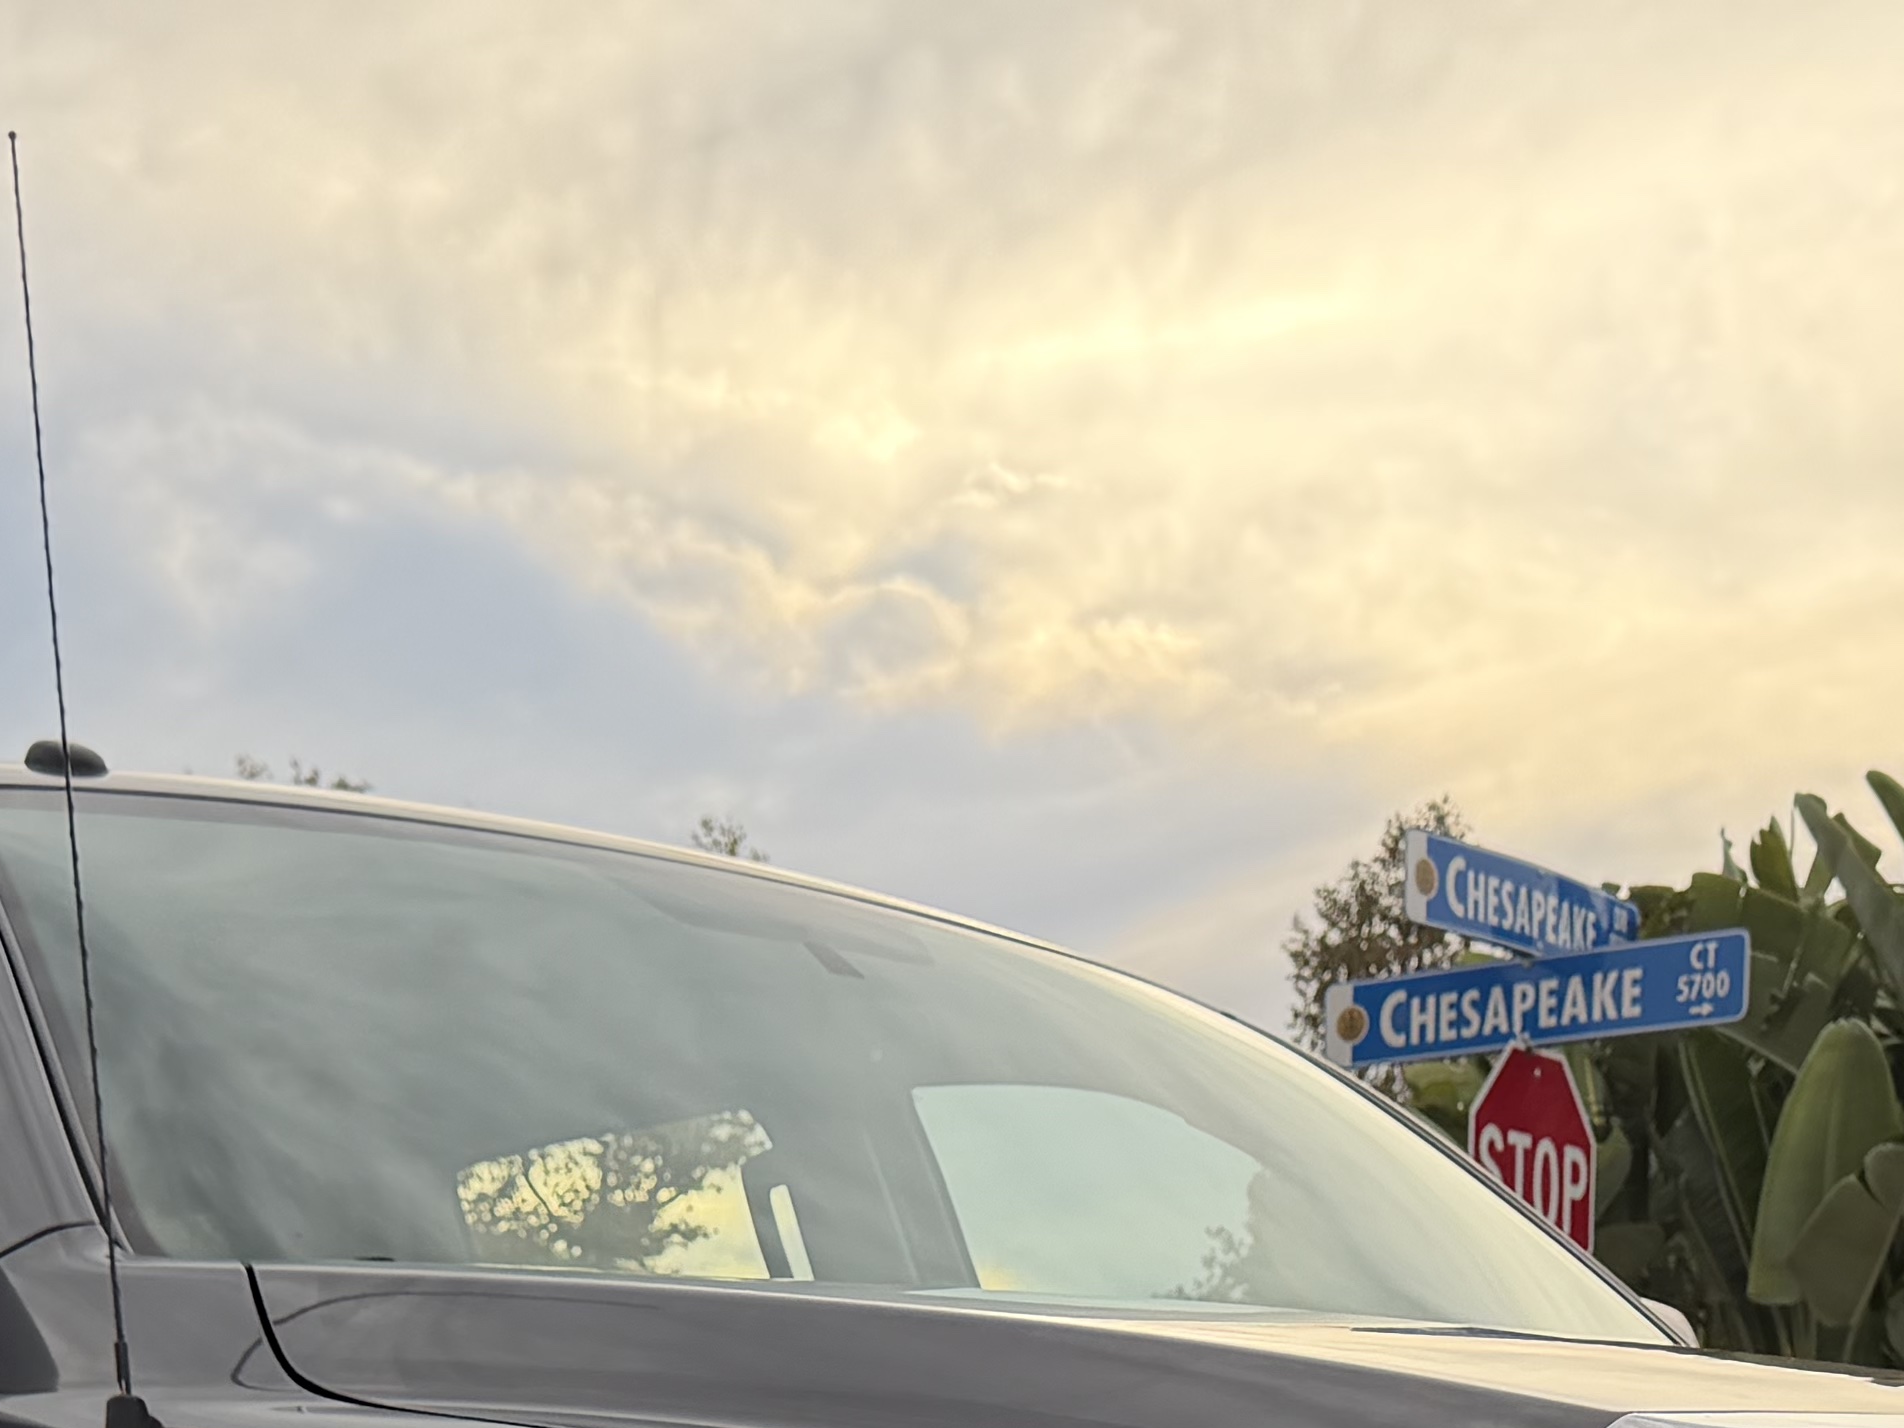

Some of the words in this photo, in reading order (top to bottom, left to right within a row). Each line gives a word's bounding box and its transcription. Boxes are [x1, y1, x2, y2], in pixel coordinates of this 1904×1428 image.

[1690, 941, 1718, 970] CT
[1379, 966, 1644, 1048] CHESAPEAKE
[1676, 968, 1730, 1003] 5700
[1478, 1122, 1588, 1236] STOP
